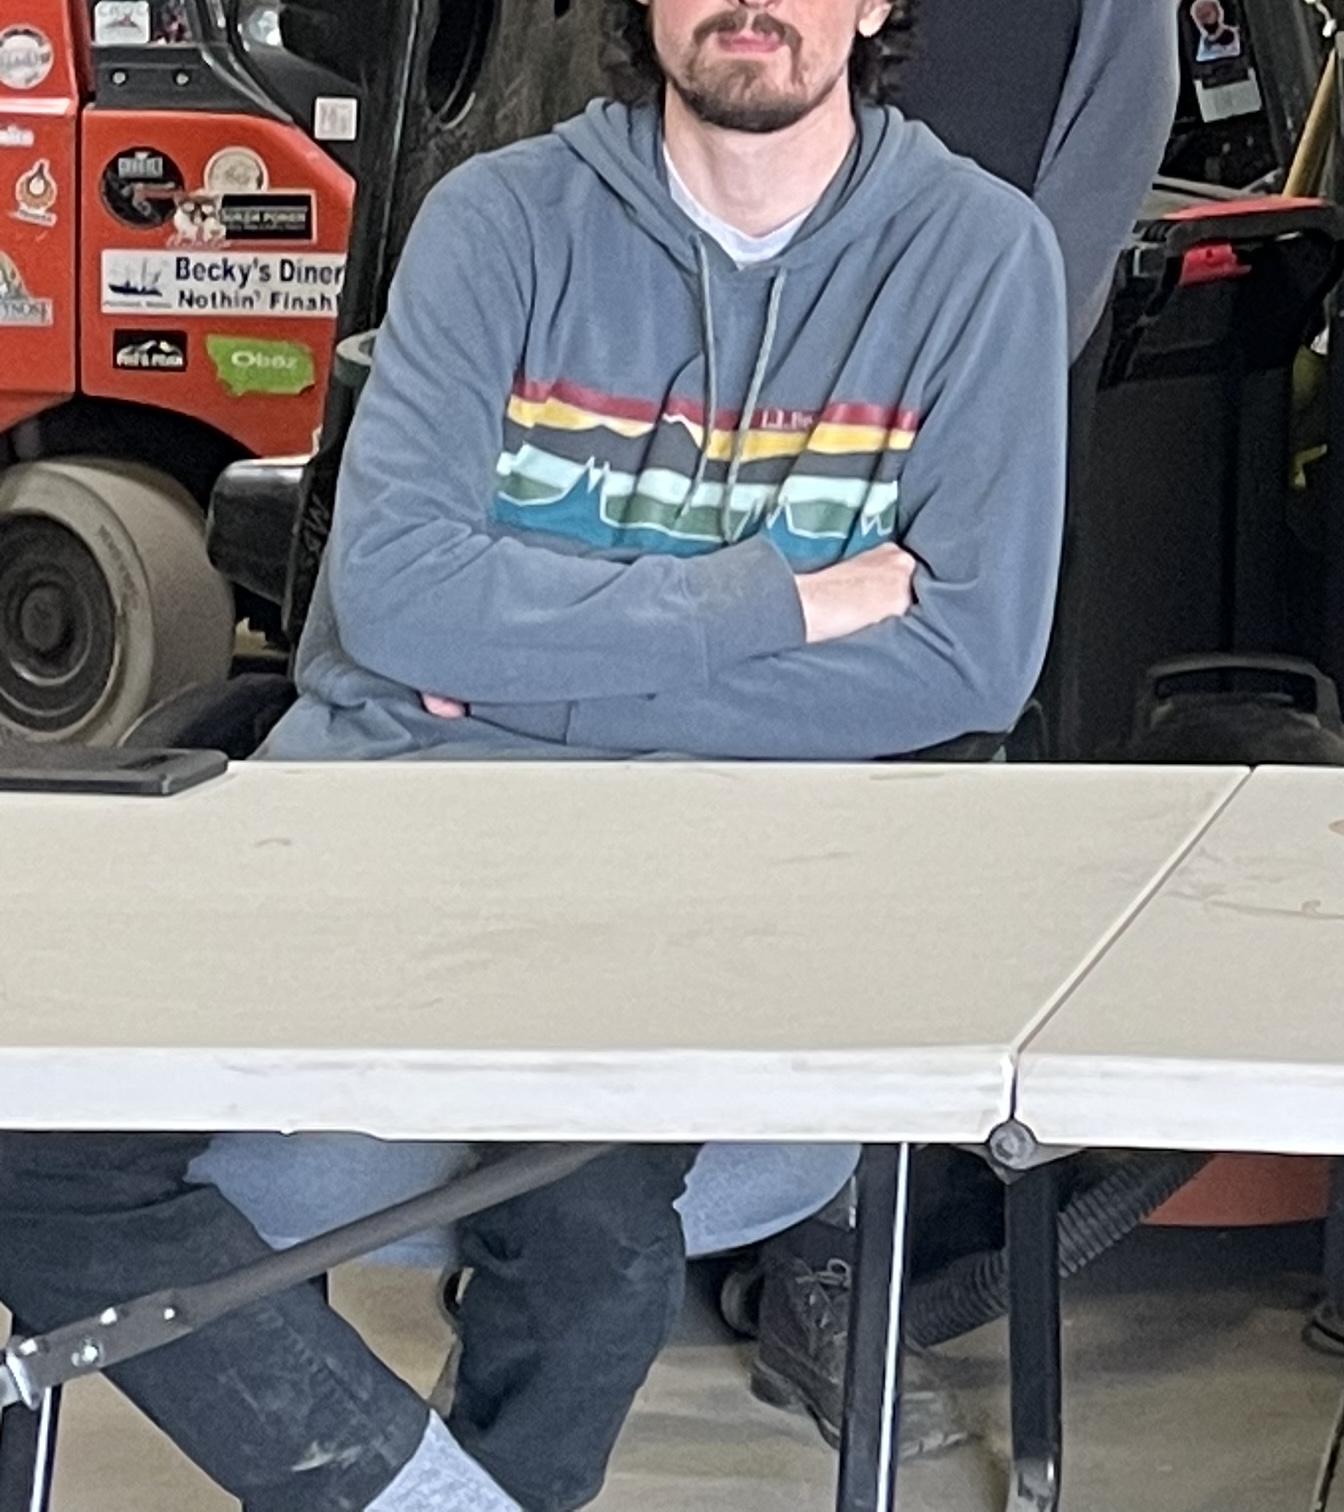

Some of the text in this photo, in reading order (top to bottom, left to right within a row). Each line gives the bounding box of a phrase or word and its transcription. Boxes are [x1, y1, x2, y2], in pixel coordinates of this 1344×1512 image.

[175, 257, 344, 289] Becky's Diner
[178, 291, 261, 310] Nothin'
